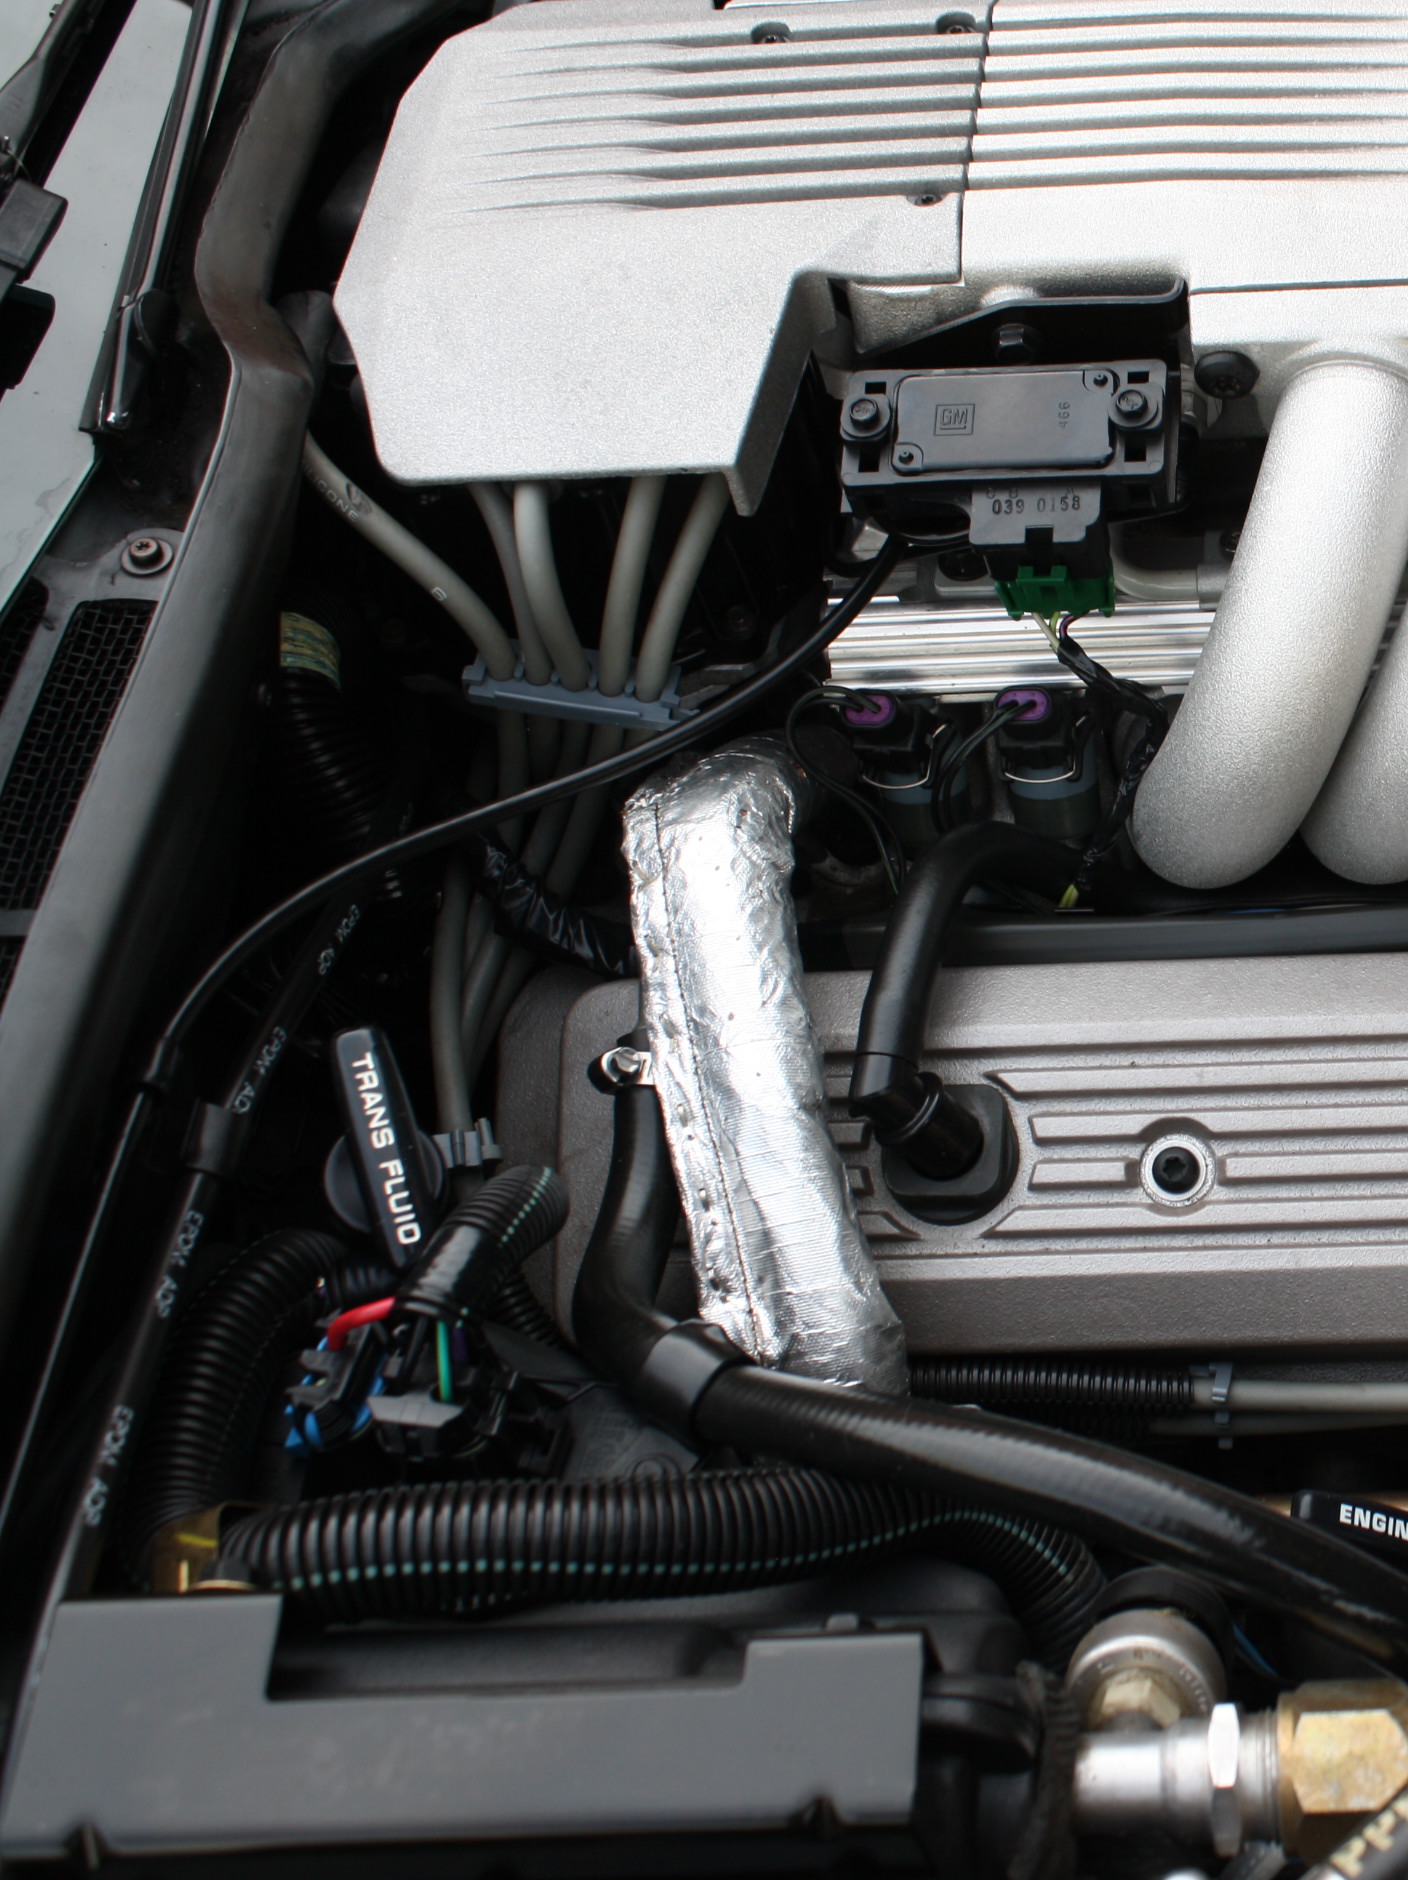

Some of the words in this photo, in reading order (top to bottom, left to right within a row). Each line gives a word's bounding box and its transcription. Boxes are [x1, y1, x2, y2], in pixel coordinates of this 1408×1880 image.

[938, 406, 970, 430] GM
[991, 499, 1025, 515] 039
[351, 1051, 396, 1150] TRANS
[378, 1158, 422, 1245] FLUID
